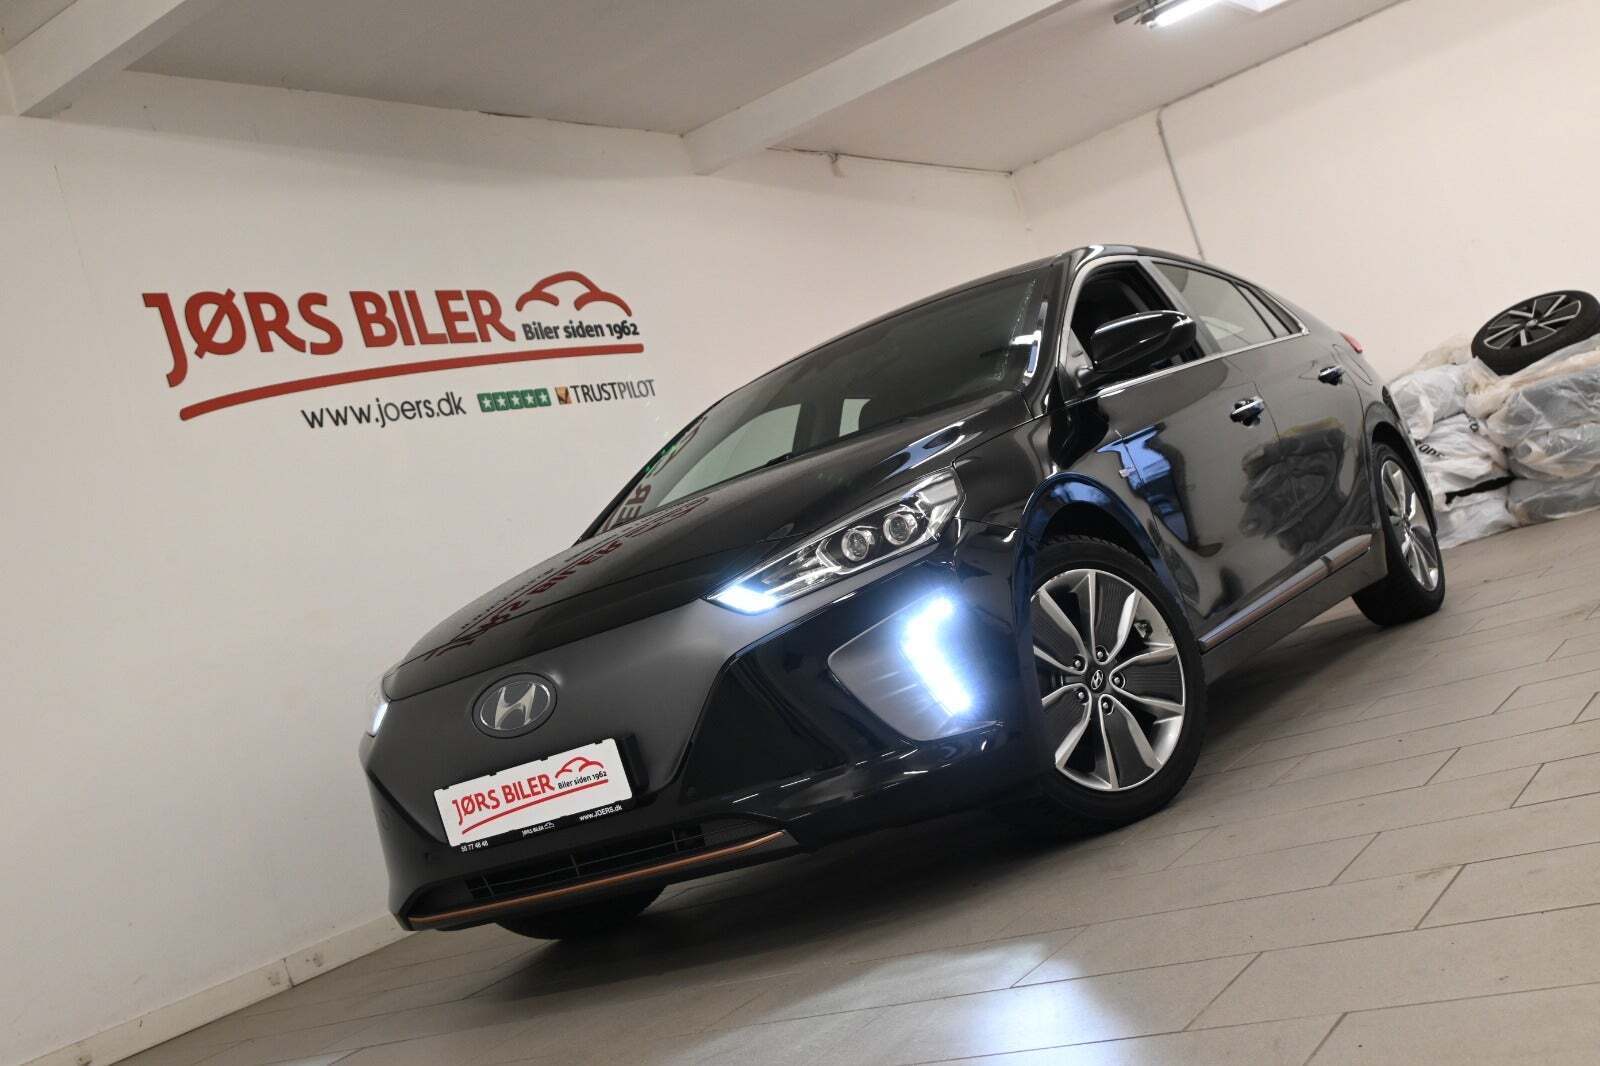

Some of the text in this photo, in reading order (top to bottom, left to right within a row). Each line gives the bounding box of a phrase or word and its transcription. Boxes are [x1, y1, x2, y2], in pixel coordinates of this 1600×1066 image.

[142, 288, 516, 388] JØRS BILER
[521, 320, 641, 342] Biler siden 1962
[569, 379, 657, 404] TRUSTPILOT
[301, 391, 467, 429] www.joers.dk
[557, 770, 608, 790] Biler siden 1962
[451, 773, 556, 826] JØRS BILER
